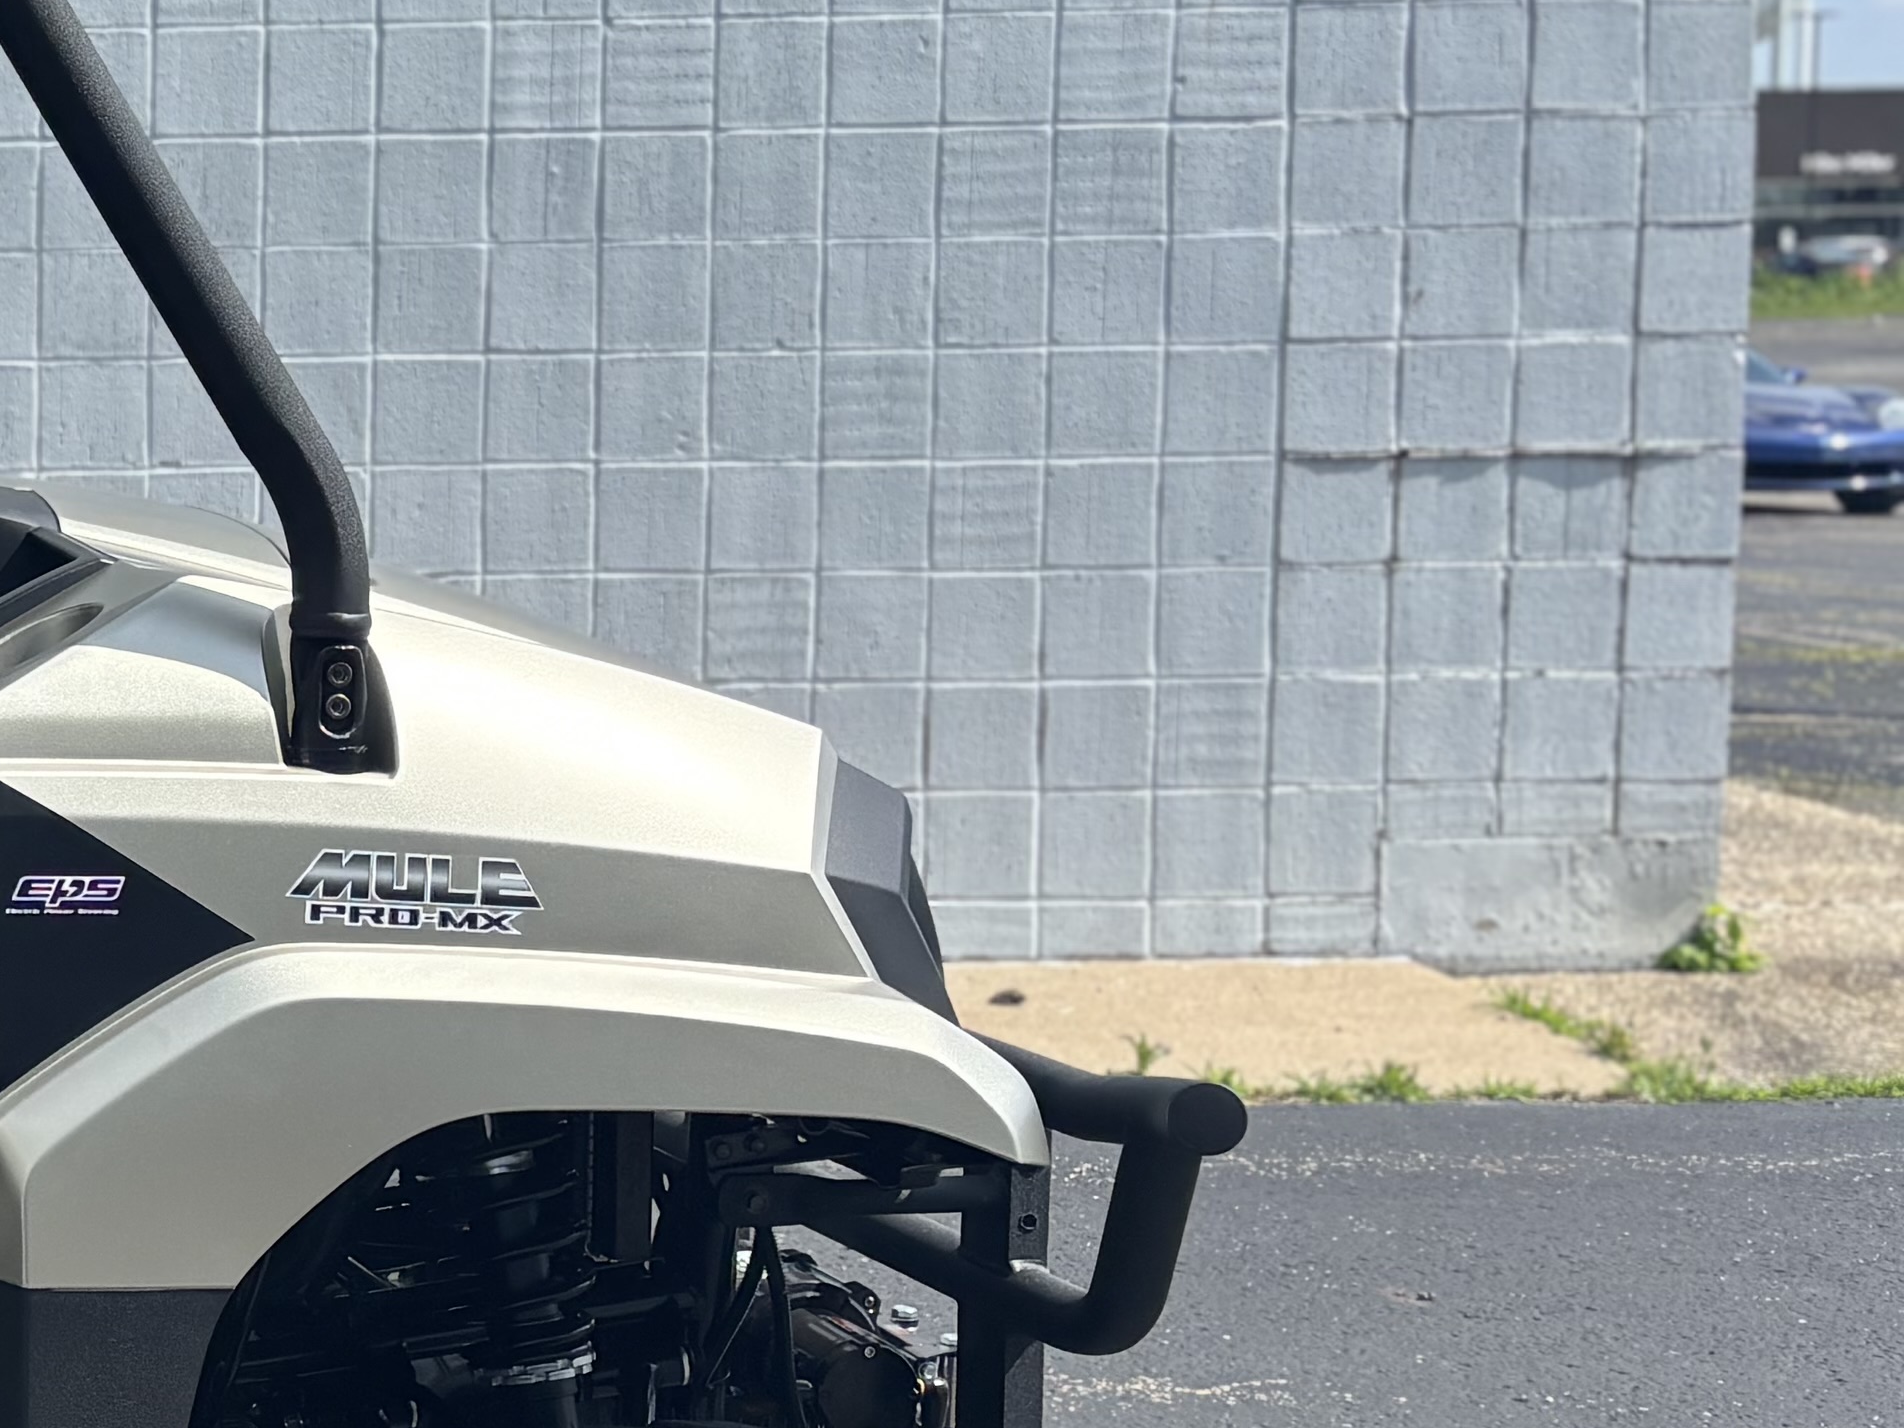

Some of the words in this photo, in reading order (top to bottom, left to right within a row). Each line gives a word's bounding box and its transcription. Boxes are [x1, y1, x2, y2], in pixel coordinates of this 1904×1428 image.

[11, 875, 126, 907] EPS
[286, 849, 544, 910] MULE
[304, 902, 523, 935] PRO-MX
